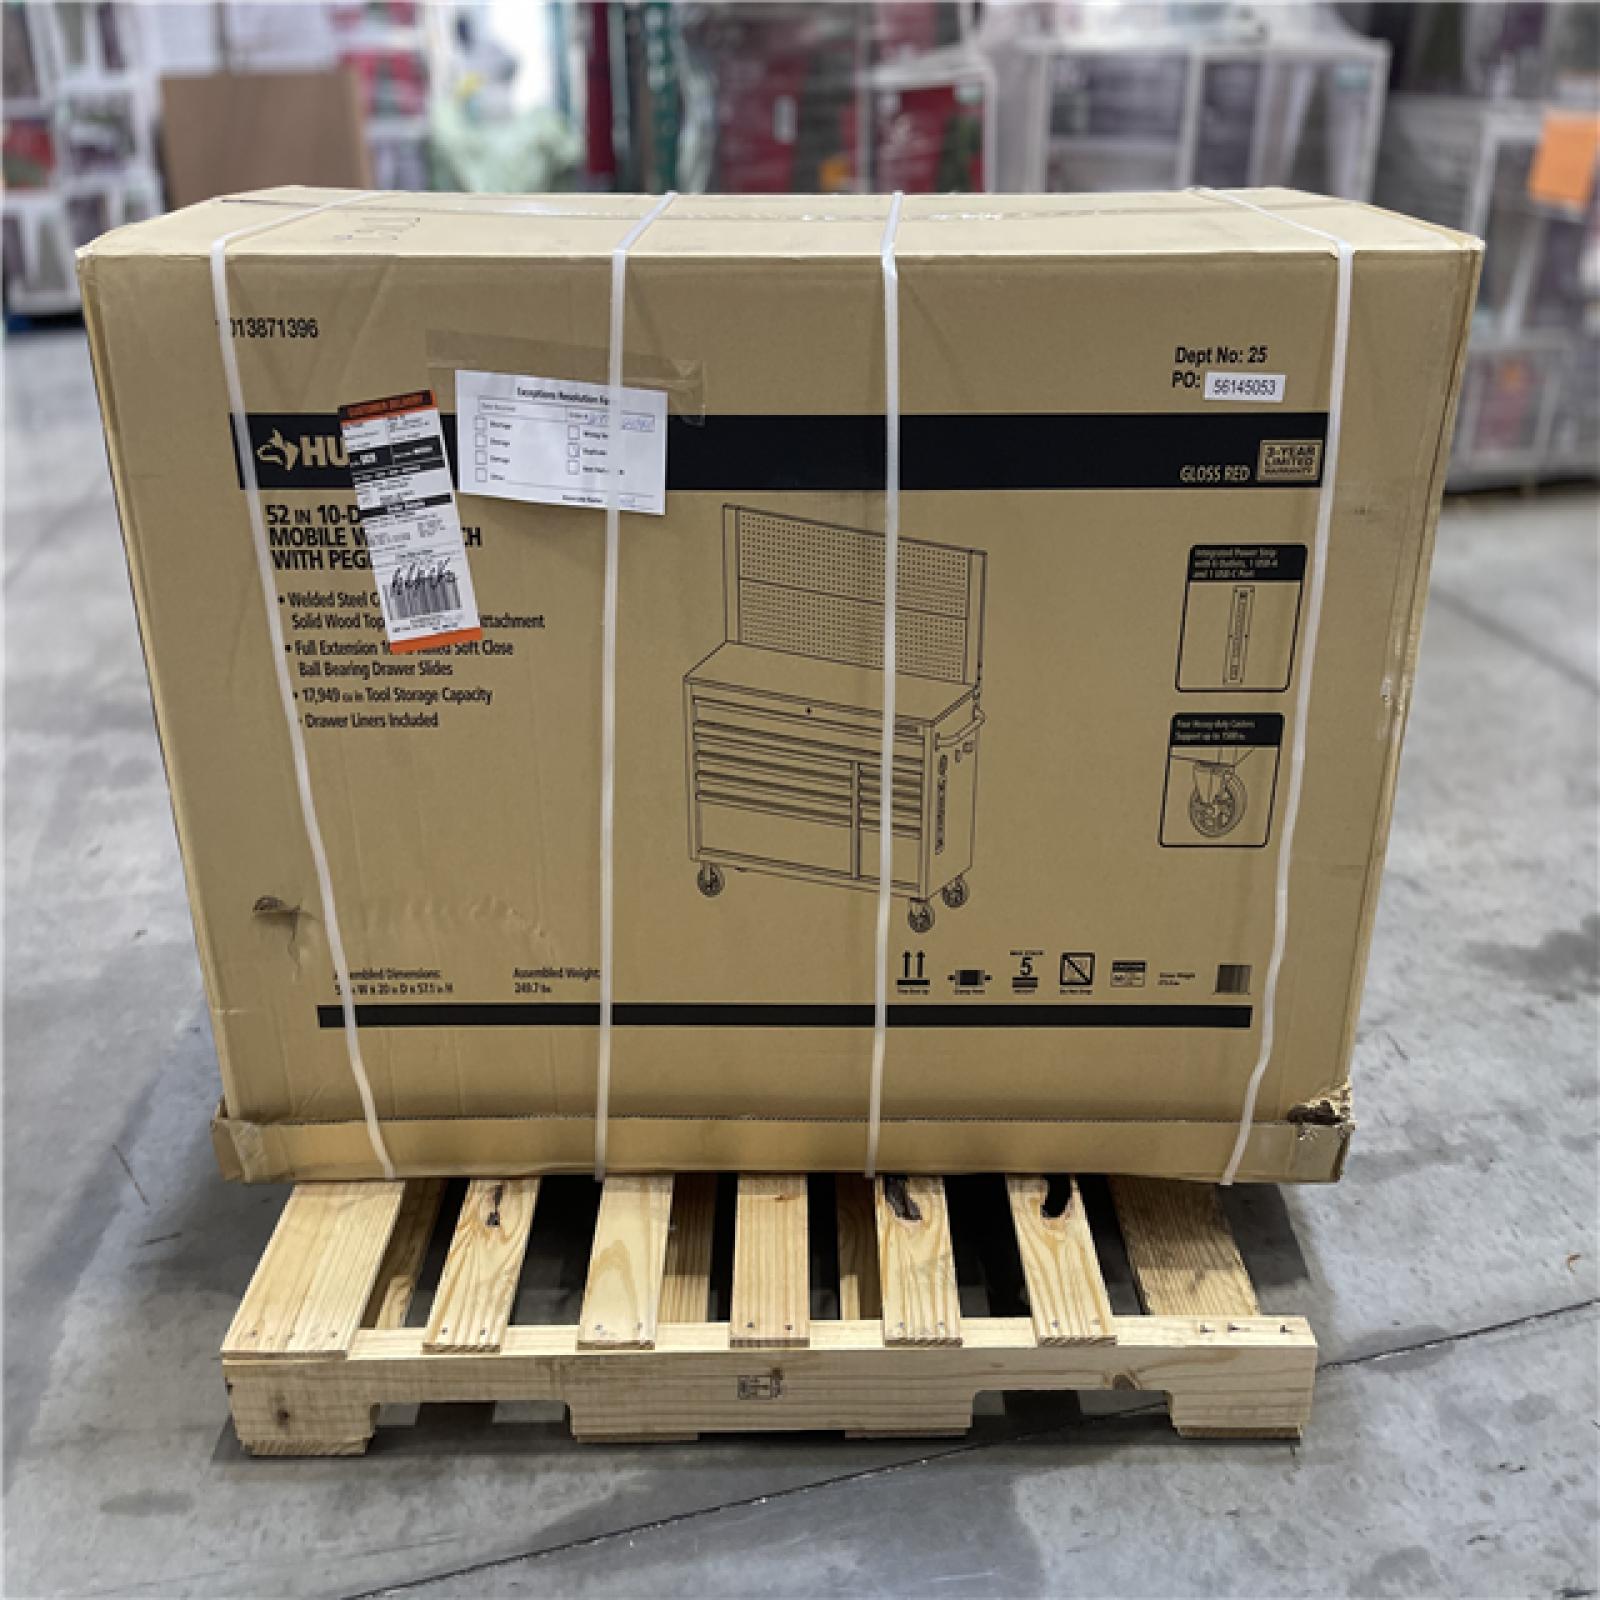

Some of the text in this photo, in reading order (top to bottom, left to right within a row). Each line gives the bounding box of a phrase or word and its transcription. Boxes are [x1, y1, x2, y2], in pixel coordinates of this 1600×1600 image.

[1174, 345, 1268, 368] Dept No: 25
[1171, 370, 1277, 396] PO: 56145053
[1178, 464, 1250, 483] GLOSS RED
[265, 504, 290, 525] 52
[295, 509, 310, 525] IN
[269, 526, 348, 547] MOBILE
[272, 549, 325, 571] WITH
[288, 592, 335, 608] Welded
[337, 592, 368, 608] Steel
[291, 612, 321, 629] Solid
[324, 612, 361, 629] Wood
[479, 611, 545, 629] ttachment
[295, 640, 318, 655] Full
[320, 640, 378, 655] Extension
[454, 640, 479, 655] Soft
[482, 639, 513, 655] Close
[299, 660, 453, 681] Ball Bearing Drawer Slides
[366, 687, 391, 703] Tool
[393, 687, 439, 706] Storage
[442, 687, 493, 706] Capacity
[305, 712, 438, 728] Drawer Liners Included
[1020, 956, 1032, 976] 5
